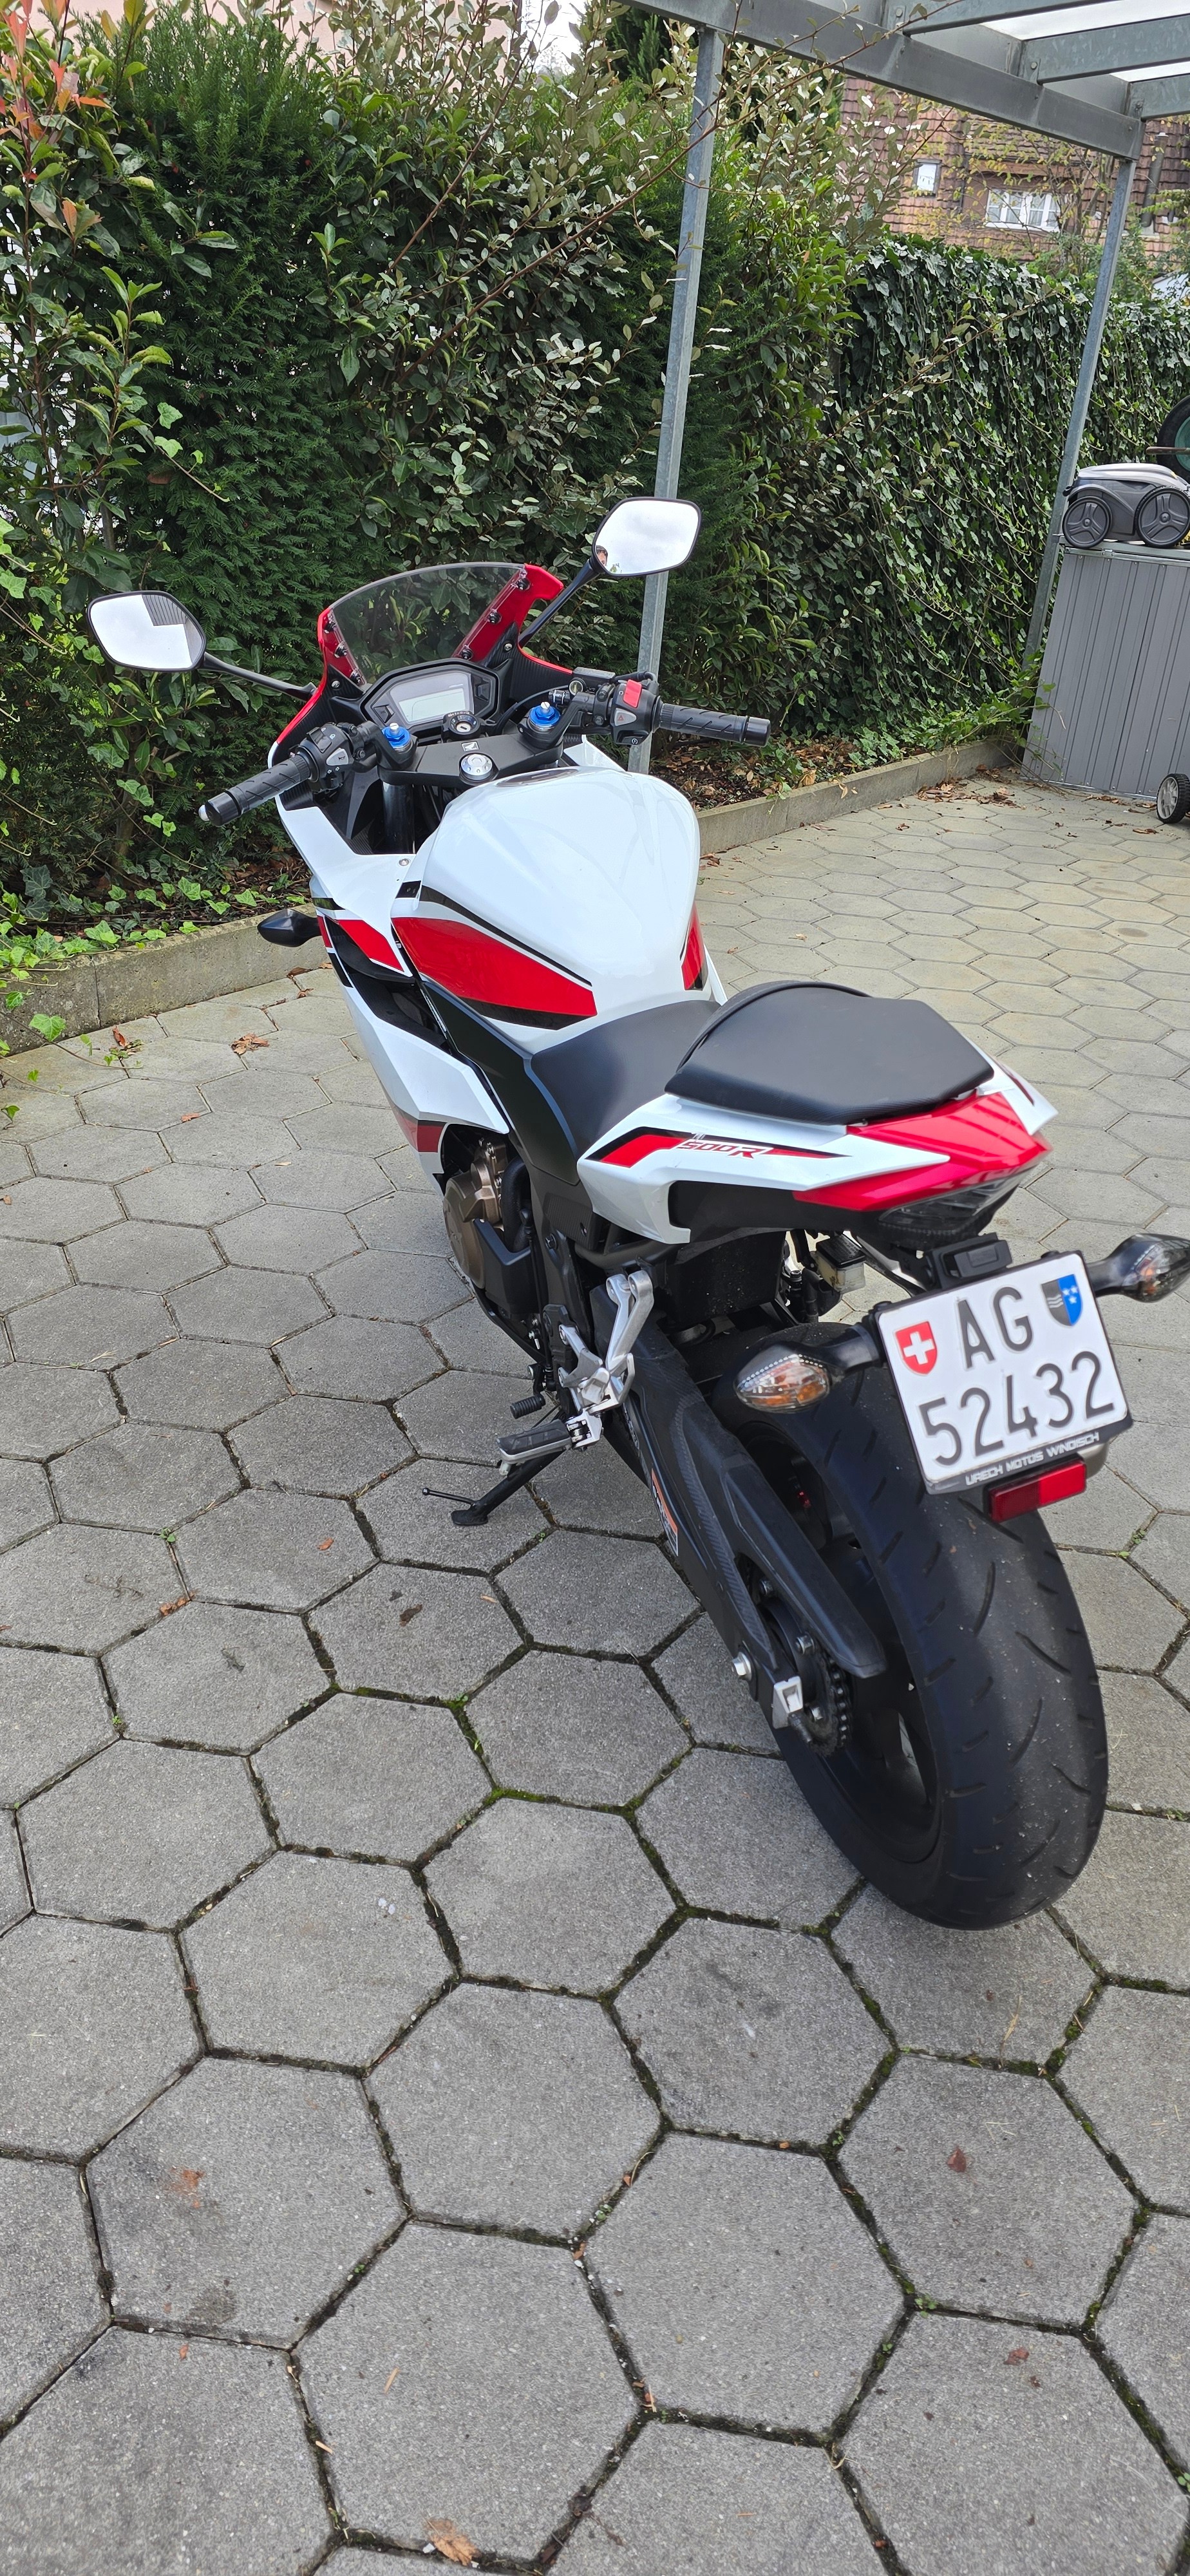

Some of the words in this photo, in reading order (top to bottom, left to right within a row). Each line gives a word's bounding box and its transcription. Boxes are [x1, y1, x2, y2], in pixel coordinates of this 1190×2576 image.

[958, 1286, 1034, 1369] AG
[918, 1350, 1115, 1466] 52432
[965, 1465, 1004, 1486] URECH
[1005, 1450, 1044, 1472] MOTOS
[1045, 1432, 1100, 1457] WINDISCH
